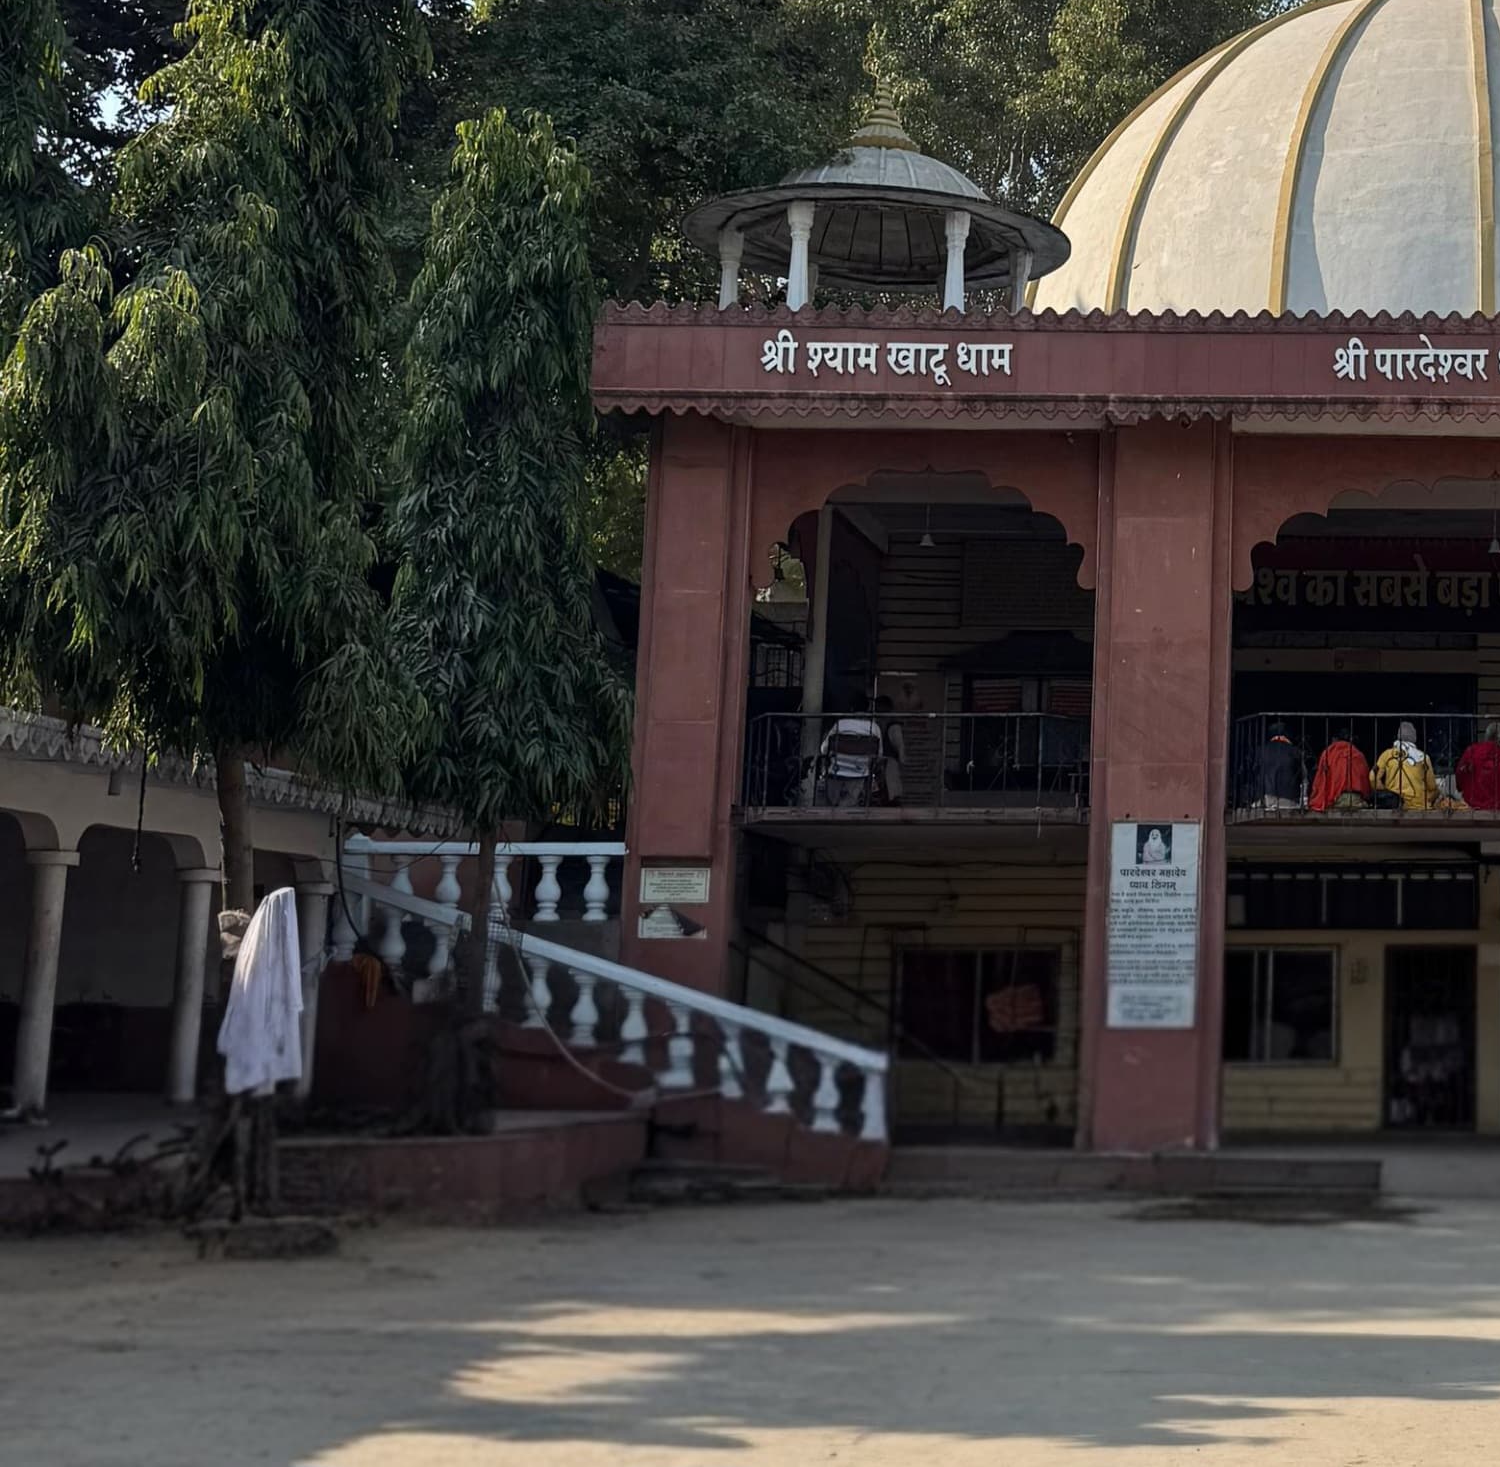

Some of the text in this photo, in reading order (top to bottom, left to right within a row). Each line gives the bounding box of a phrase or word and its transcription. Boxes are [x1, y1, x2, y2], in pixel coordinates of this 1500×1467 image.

[760, 328, 1014, 386] श्री श्याम खाटू धाम
[1332, 337, 1369, 381] श्री
[1373, 333, 1490, 383] पारदेश्वर
[1303, 568, 1349, 607] का
[1352, 552, 1430, 608] सबसे
[1435, 569, 1493, 617] बड़ा
